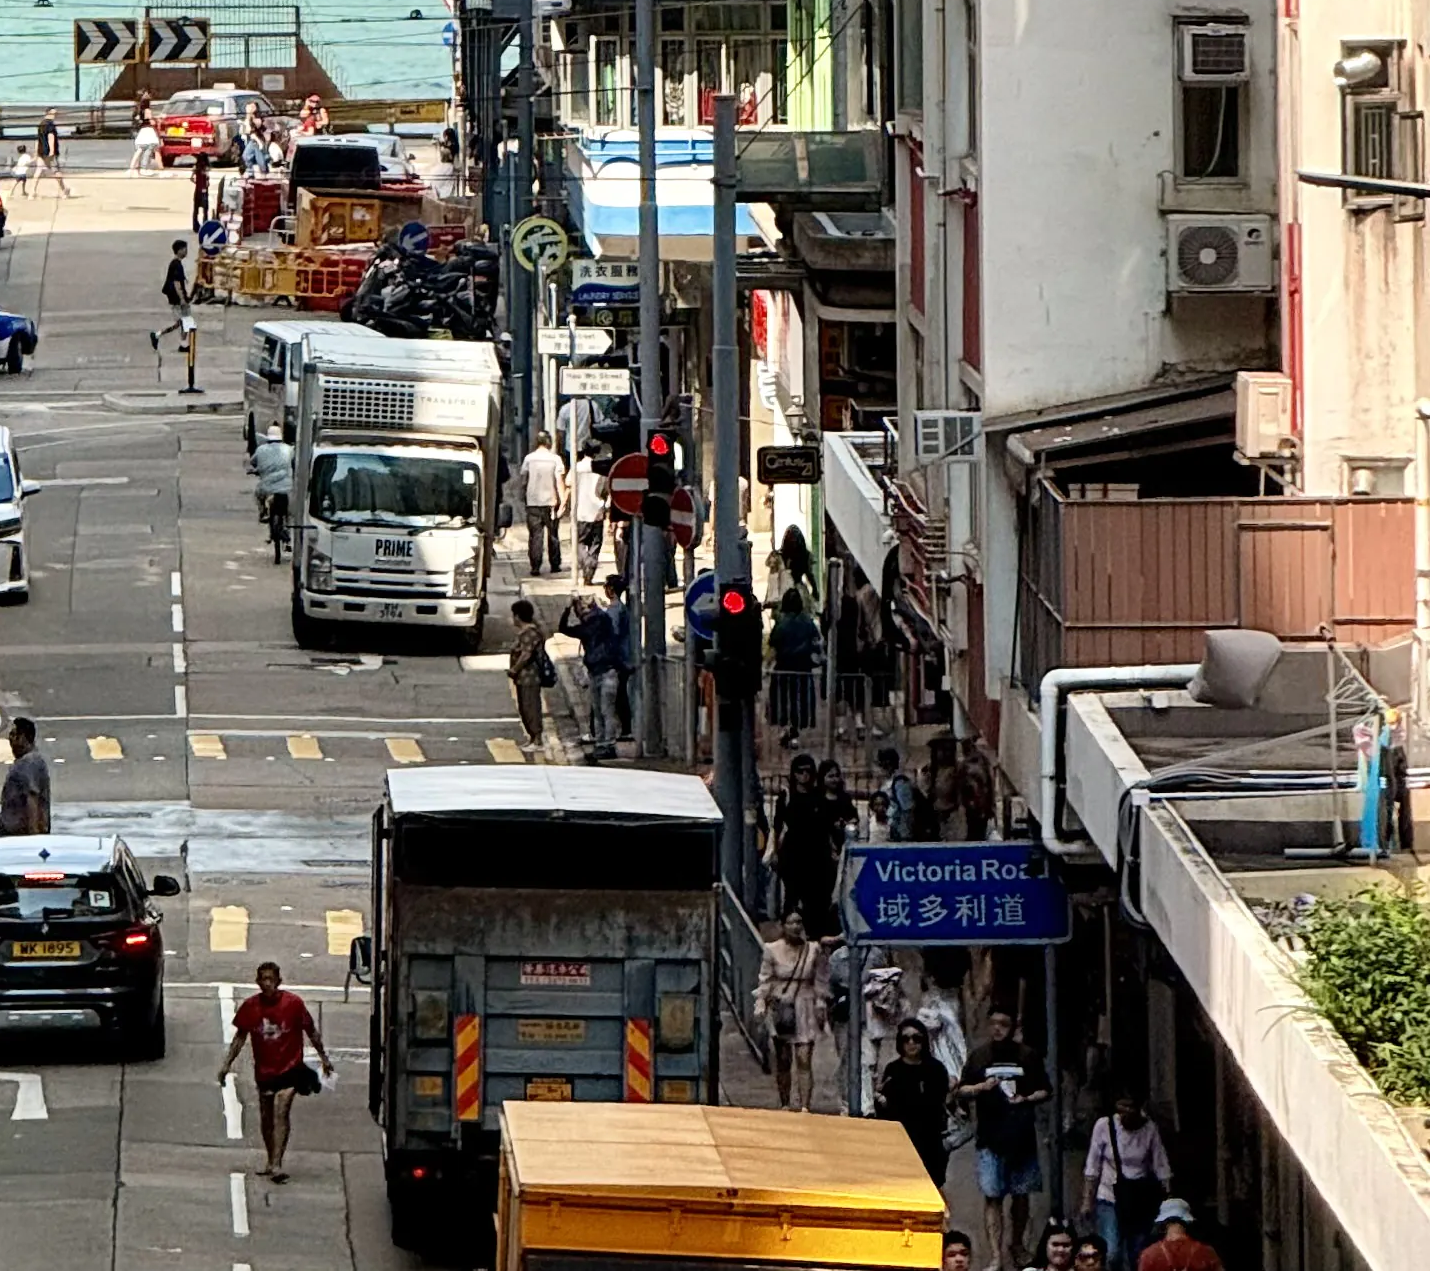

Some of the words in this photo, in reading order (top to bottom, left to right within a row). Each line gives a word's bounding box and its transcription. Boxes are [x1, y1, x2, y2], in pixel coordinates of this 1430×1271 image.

[375, 539, 414, 557] PRIME
[875, 859, 977, 882] Victoria
[94, 893, 106, 904] P
[876, 893, 1026, 928] 域多利道
[42, 942, 74, 955] 1895
